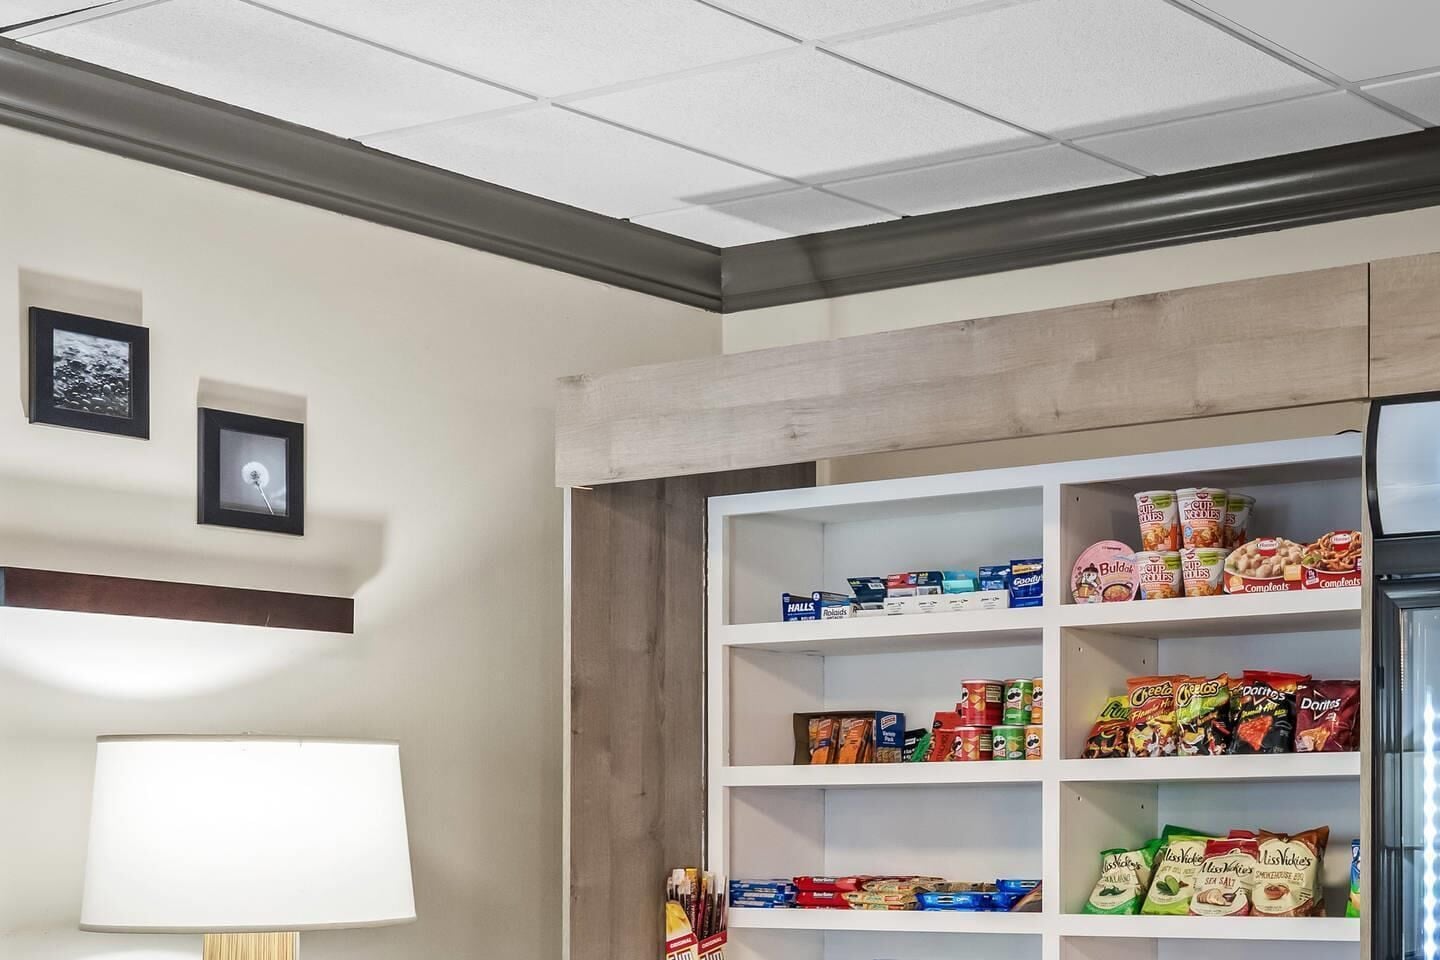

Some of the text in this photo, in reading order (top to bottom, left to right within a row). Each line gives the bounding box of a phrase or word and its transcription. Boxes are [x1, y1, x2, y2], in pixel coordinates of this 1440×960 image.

[1190, 501, 1214, 511] CUP
[1184, 510, 1221, 521] NOODLES
[1099, 561, 1134, 576] Buldak
[1244, 582, 1289, 593] Compleats
[1319, 577, 1361, 589] Compleats
[787, 602, 815, 613] HALLS
[823, 608, 848, 617] Rolaids
[1131, 682, 1174, 707] Cheeto
[1176, 681, 1220, 707] Cheetos
[1242, 686, 1286, 701] Doritos
[1300, 698, 1342, 711] Doritos
[1204, 877, 1236, 888] SEA SALT
